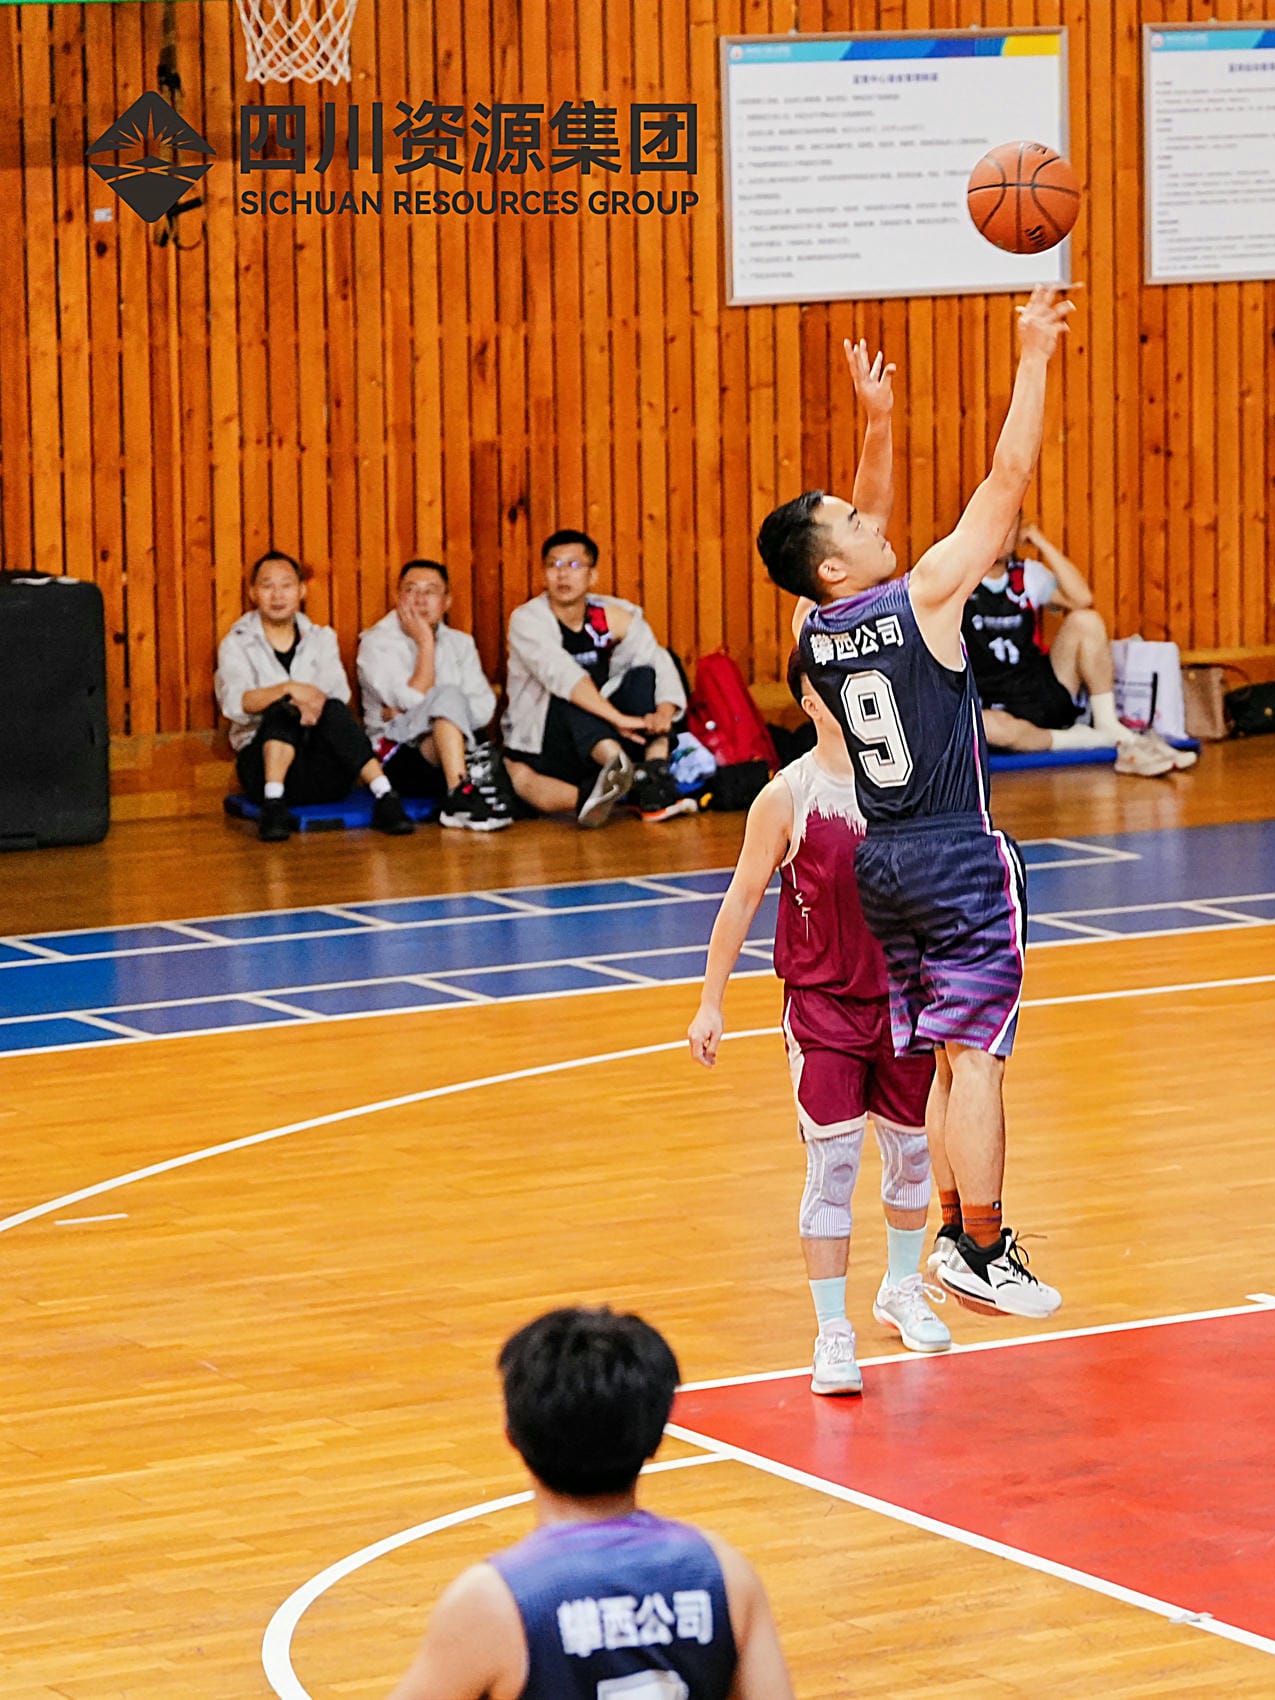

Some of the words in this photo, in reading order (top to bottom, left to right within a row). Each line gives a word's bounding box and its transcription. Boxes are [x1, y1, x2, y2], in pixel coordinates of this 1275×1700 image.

[810, 614, 904, 666] 攀西公司
[840, 669, 914, 789] 9
[556, 1589, 713, 1658] 攀西公司
